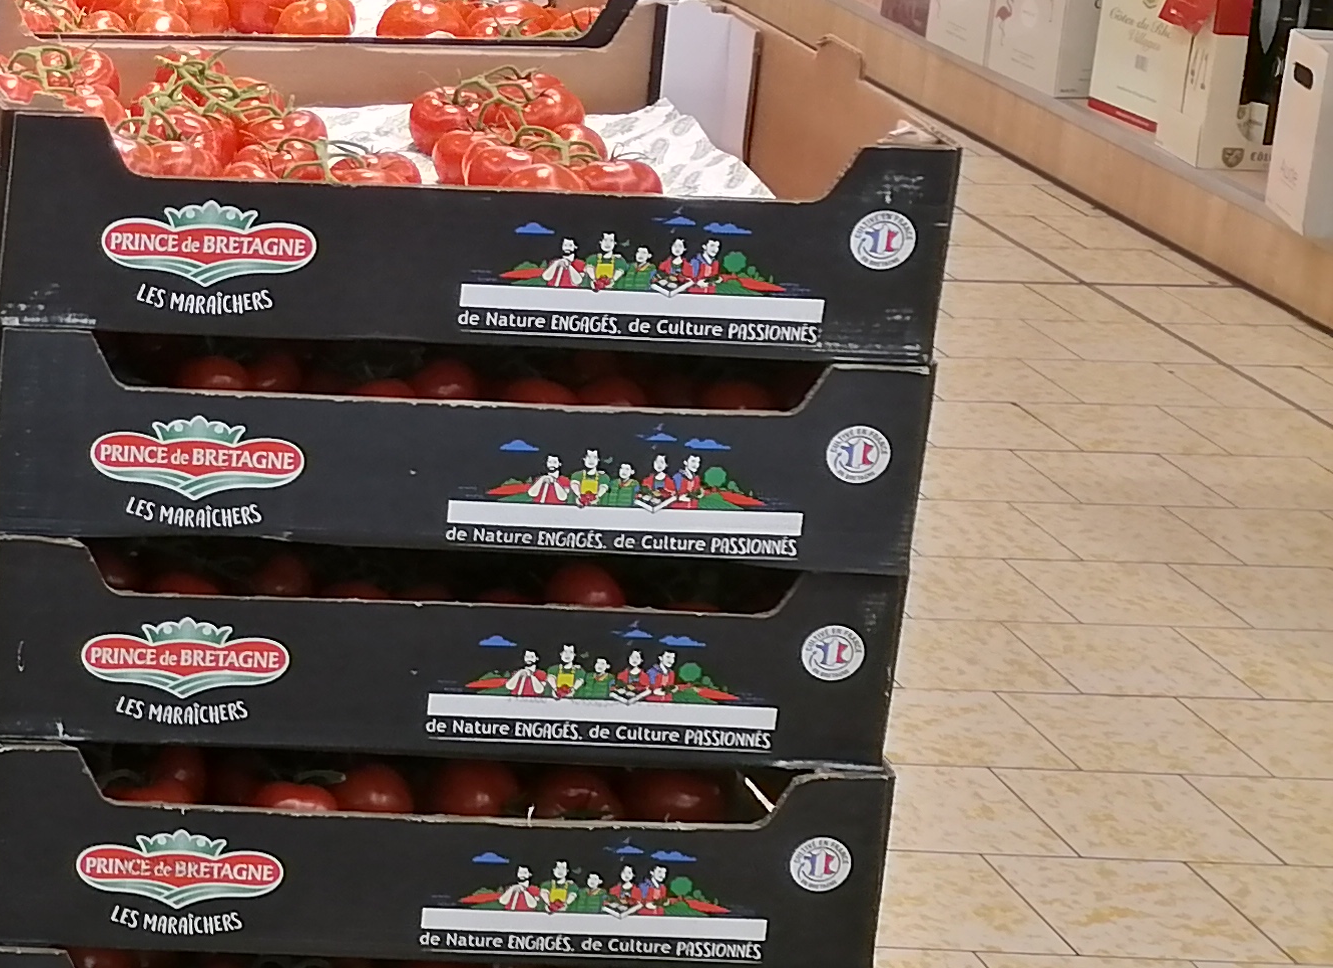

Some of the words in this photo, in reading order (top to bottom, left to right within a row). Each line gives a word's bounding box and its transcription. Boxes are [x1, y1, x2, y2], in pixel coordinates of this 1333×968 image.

[110, 232, 178, 253] PRINCE
[181, 238, 200, 253] de
[202, 235, 306, 257] BRETAGNE
[136, 283, 166, 309] LES
[169, 288, 274, 315] MARAÎCHERS
[458, 310, 480, 326] de
[486, 311, 546, 329] Nature
[628, 319, 651, 334] de
[656, 318, 724, 337] Culture
[728, 323, 818, 345] PASSIONNÉS
[100, 444, 168, 464] PRINCE
[171, 449, 189, 465] de
[192, 447, 295, 469] BRETAGNE
[126, 496, 156, 522] LES
[159, 503, 263, 529] MARAÎCHERS
[445, 526, 467, 542] de
[474, 528, 532, 545] Nature
[613, 535, 635, 550] de
[640, 534, 707, 553] Culture
[710, 536, 798, 557] PASSIONNÉS
[90, 647, 157, 666] PRINCE
[160, 650, 178, 666] de
[180, 649, 280, 669] BRETAGNE
[116, 695, 145, 720] LES
[148, 700, 248, 726] MARAÎCHERS
[425, 718, 447, 734] de
[452, 719, 511, 736] Nature
[589, 726, 612, 741] de
[616, 726, 680, 744] Culture
[685, 729, 772, 750] PASSIONNÉS
[85, 856, 151, 876] PRINCE
[154, 861, 172, 877] de
[174, 861, 274, 881] BRETAGNE
[111, 905, 139, 930] LES
[143, 912, 243, 935] MARAÎCHERS
[419, 932, 441, 947] de
[446, 932, 504, 949] Nature
[581, 938, 603, 953] de
[608, 938, 672, 957] Culture
[676, 940, 762, 960] PASSIONNÉS
